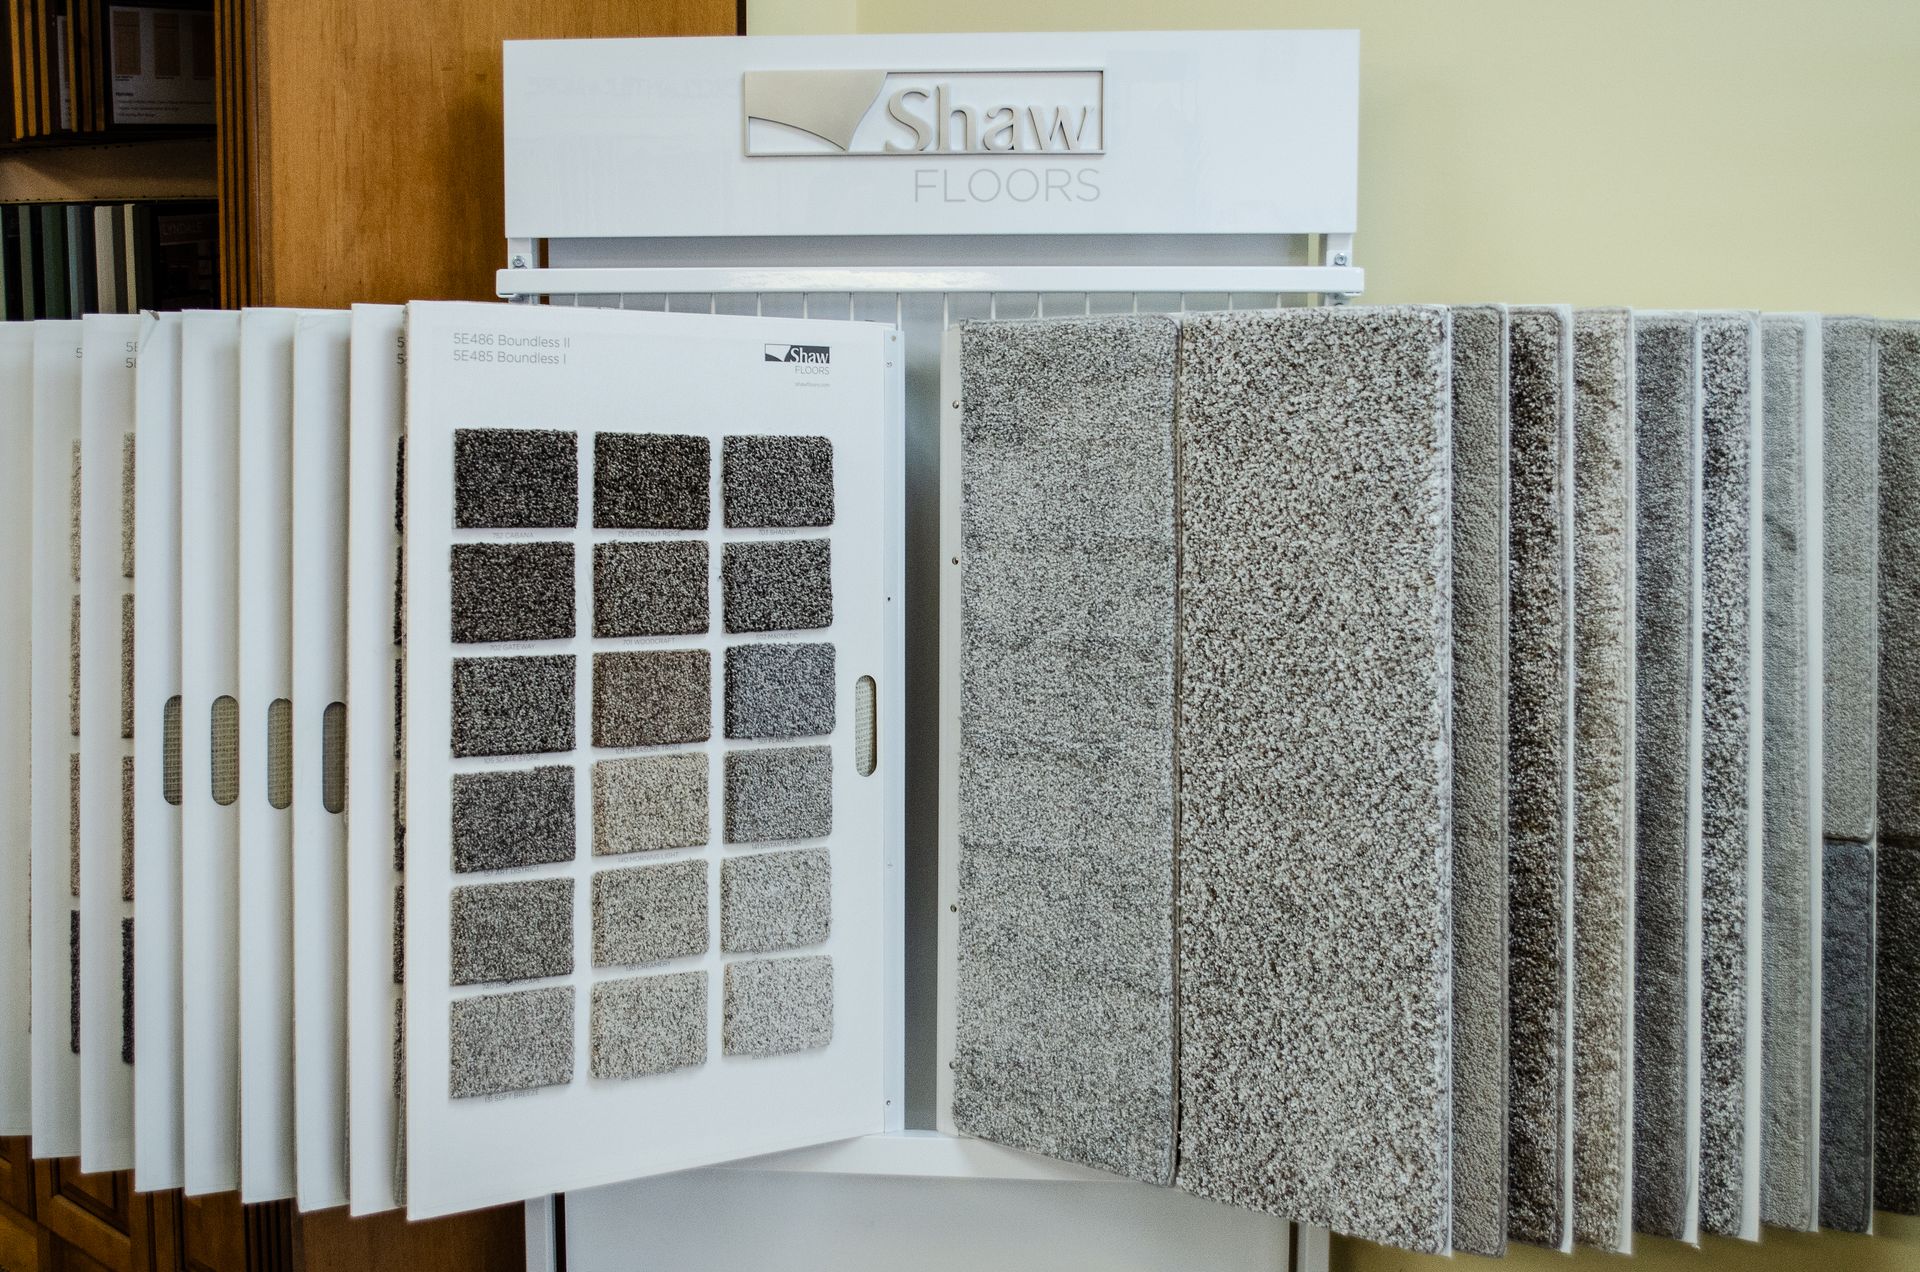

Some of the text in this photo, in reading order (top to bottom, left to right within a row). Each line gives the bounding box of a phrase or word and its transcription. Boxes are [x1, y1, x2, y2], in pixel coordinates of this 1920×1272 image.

[884, 83, 1093, 152] Shaw
[914, 168, 1101, 203] FLOORS
[453, 332, 494, 346] 5E486
[498, 334, 560, 348] Boundless
[453, 349, 494, 362] 5E485
[497, 351, 560, 364] Boundless
[789, 346, 829, 364] Shaw
[795, 365, 830, 375] FLOORS
[502, 643, 536, 651] GATEWAY
[634, 637, 675, 645] WOODCRAFT
